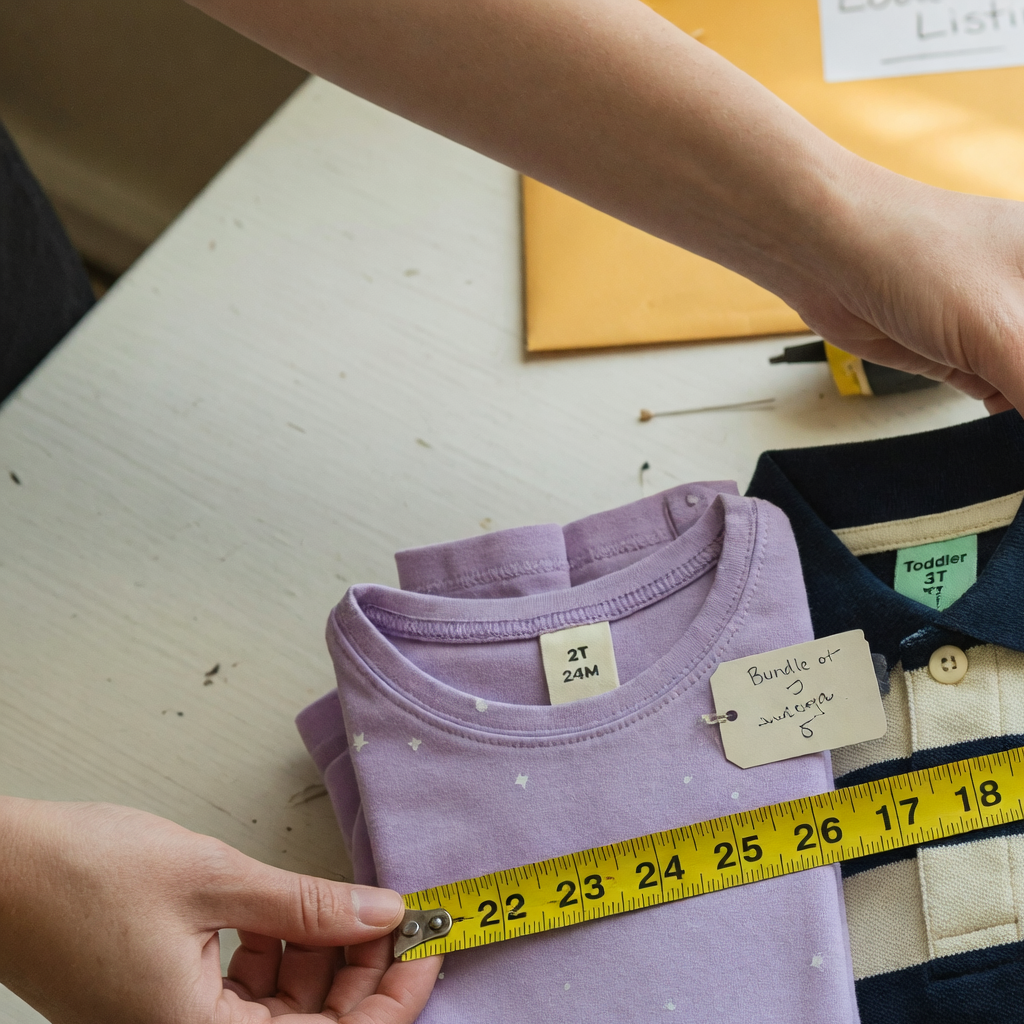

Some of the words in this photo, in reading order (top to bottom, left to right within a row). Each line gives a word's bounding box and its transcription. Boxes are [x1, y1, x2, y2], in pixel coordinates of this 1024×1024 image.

[903, 553, 967, 572] Toddler
[924, 570, 947, 584] 3T
[567, 646, 588, 662] 2T
[562, 665, 599, 683] 24M
[747, 658, 810, 686] Bundle
[477, 893, 526, 928] 22
[555, 874, 606, 908] 23
[634, 855, 685, 889] 24
[713, 835, 763, 869] 25
[793, 817, 843, 851] 26
[875, 797, 920, 831] 17
[954, 780, 1002, 812] 18
